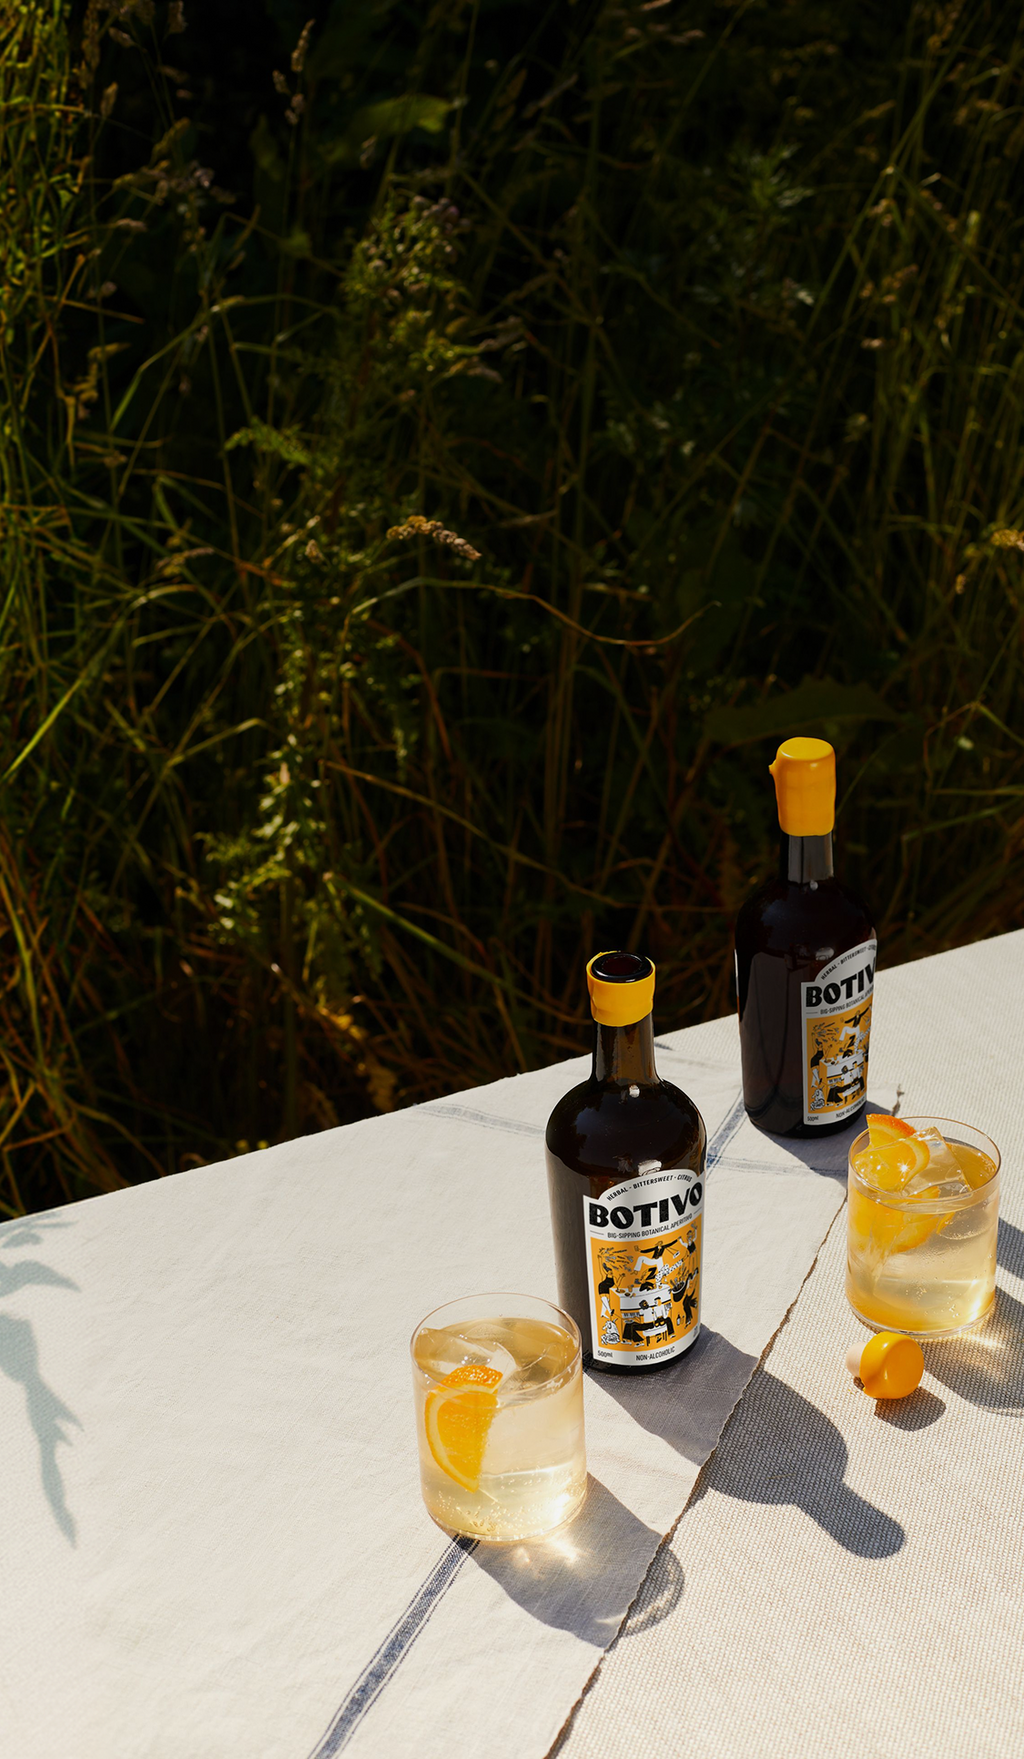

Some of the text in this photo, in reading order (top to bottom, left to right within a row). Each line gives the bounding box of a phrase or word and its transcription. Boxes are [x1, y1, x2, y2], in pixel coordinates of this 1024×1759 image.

[806, 956, 876, 1008] BOTIV
[821, 965, 838, 980] HERBAL
[606, 1174, 693, 1201] HERBAL BITTERSWEET CITRUS
[589, 1181, 703, 1229] BOTIVO
[607, 1230, 641, 1239] BIG-SIPPING
[641, 1225, 670, 1238] BOTANICAL
[635, 1346, 676, 1361] NON-ALCOHOLIC
